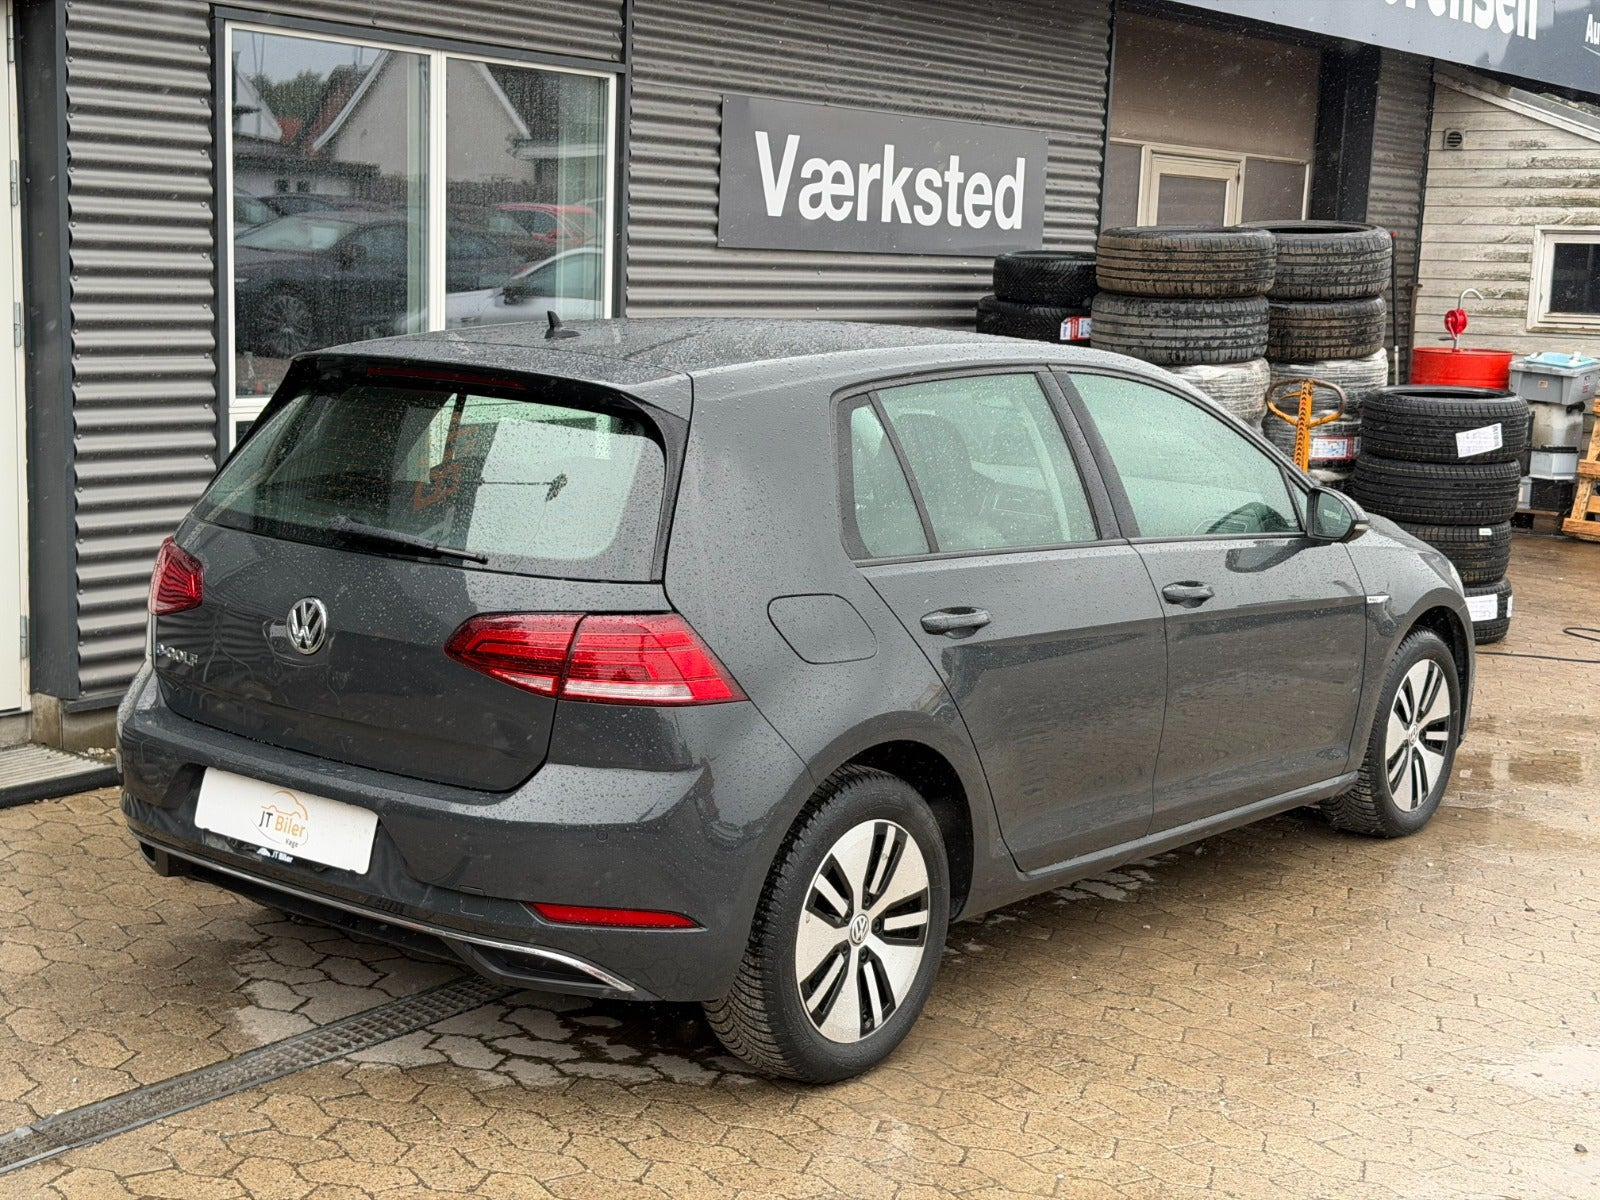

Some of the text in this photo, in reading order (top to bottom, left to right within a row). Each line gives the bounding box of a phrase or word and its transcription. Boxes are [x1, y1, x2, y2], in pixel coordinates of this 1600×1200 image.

[755, 130, 1026, 230] Værksted
[259, 811, 305, 837] JT Biler
